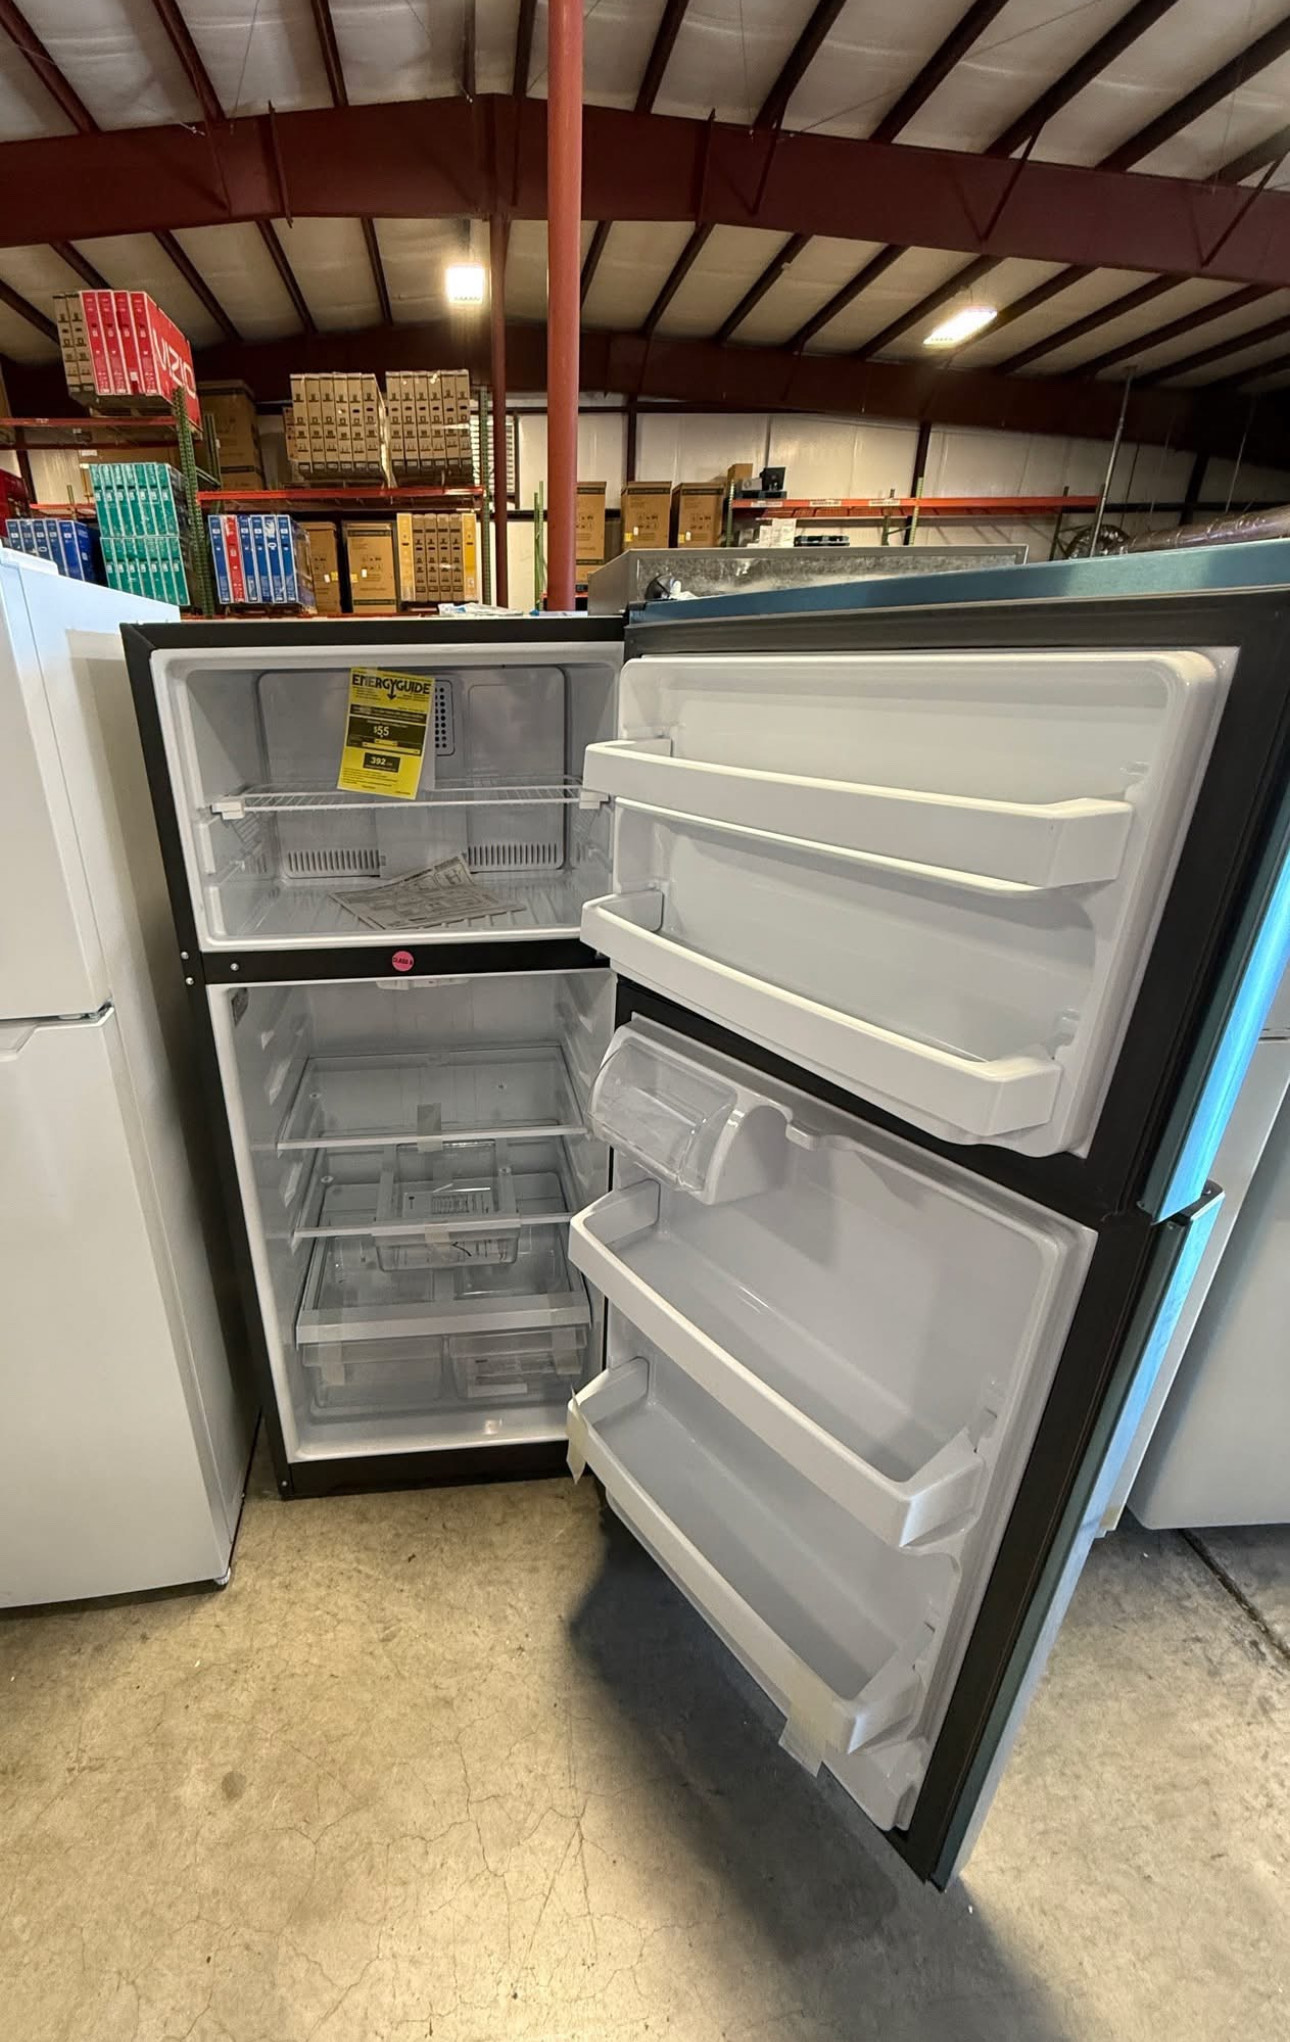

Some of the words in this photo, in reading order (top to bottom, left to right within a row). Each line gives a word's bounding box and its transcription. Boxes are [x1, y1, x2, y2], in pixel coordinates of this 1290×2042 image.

[152, 328, 197, 400] VIZIO
[352, 674, 432, 696] ENERGYGUIDE
[373, 725, 390, 736] $55
[370, 756, 387, 766] 392
